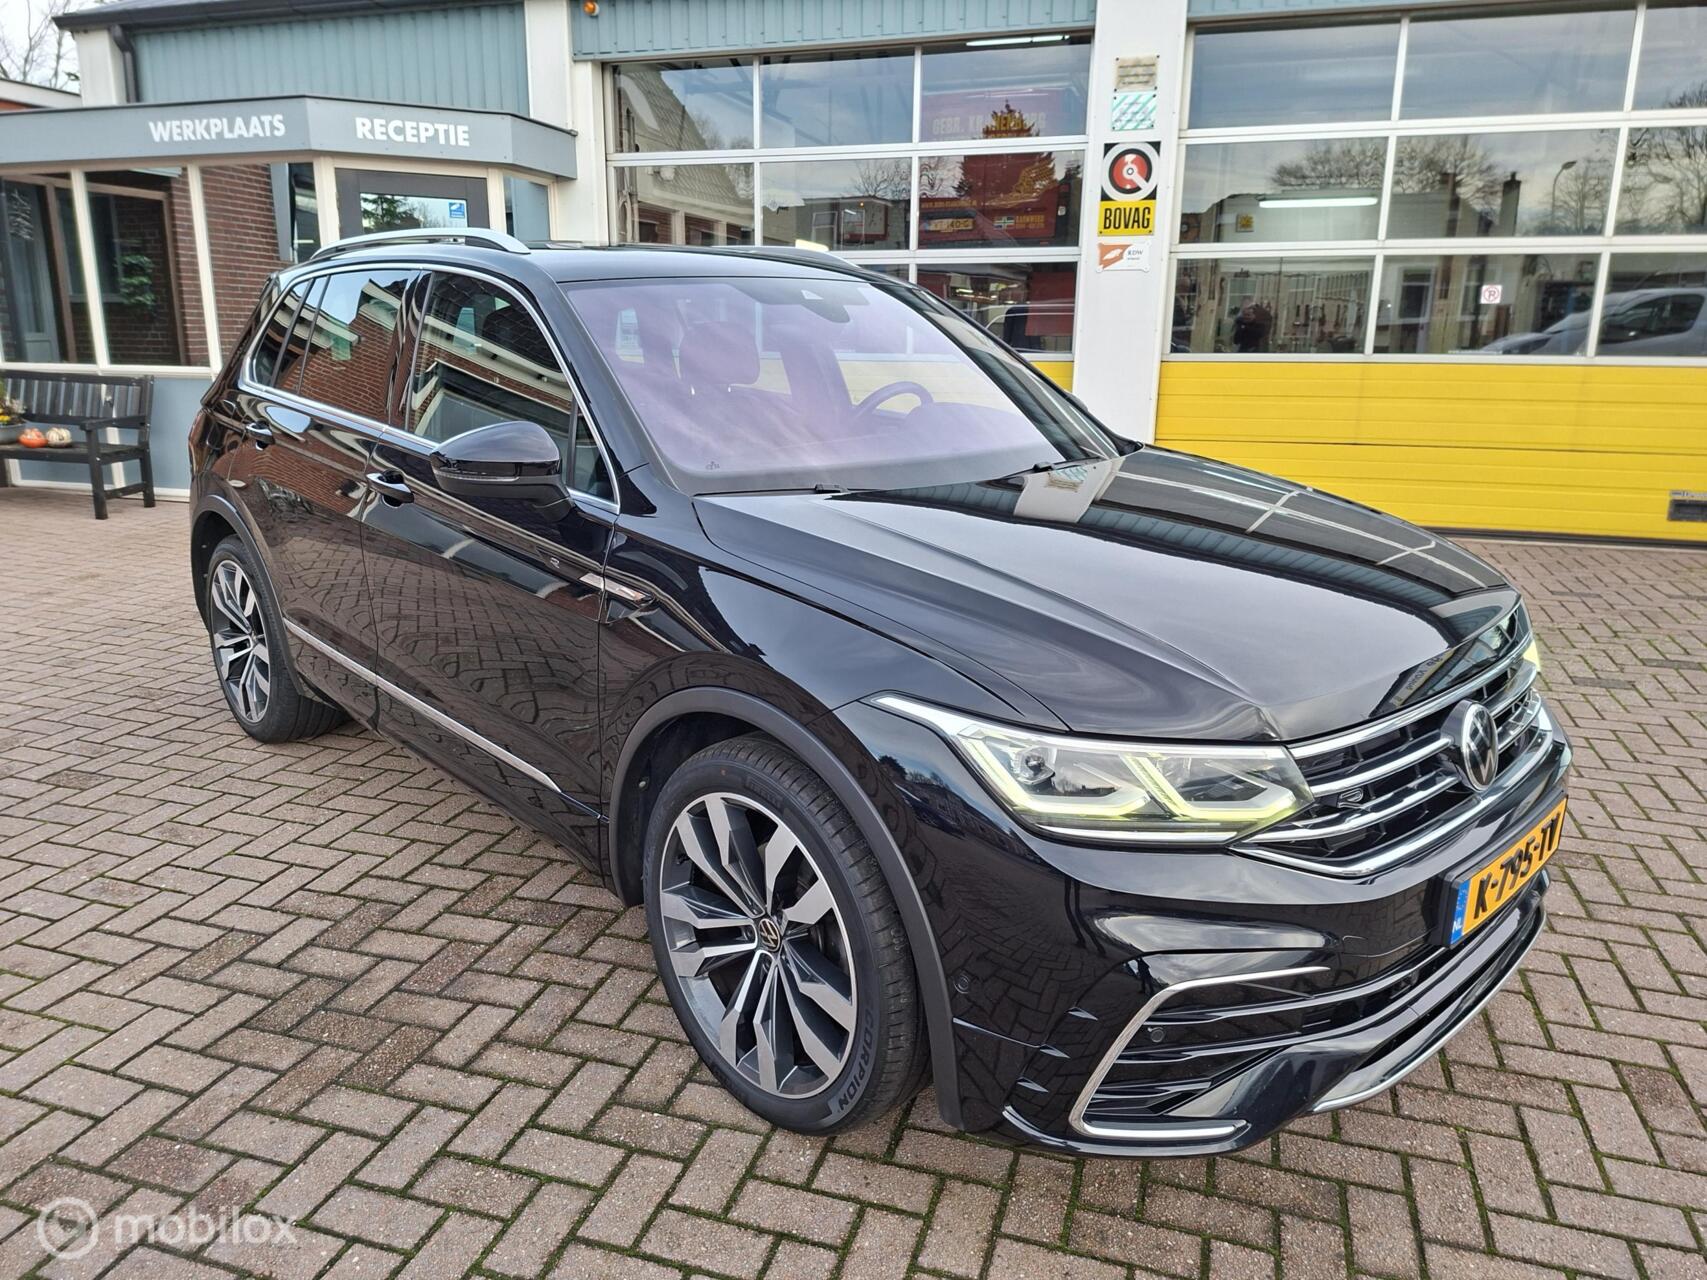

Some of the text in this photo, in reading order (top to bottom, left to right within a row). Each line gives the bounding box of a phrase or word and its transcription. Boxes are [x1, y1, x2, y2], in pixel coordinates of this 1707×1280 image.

[148, 114, 286, 142] WERKPLAATS
[355, 116, 471, 147] RECEPTIE
[1103, 206, 1151, 230] BOVAG
